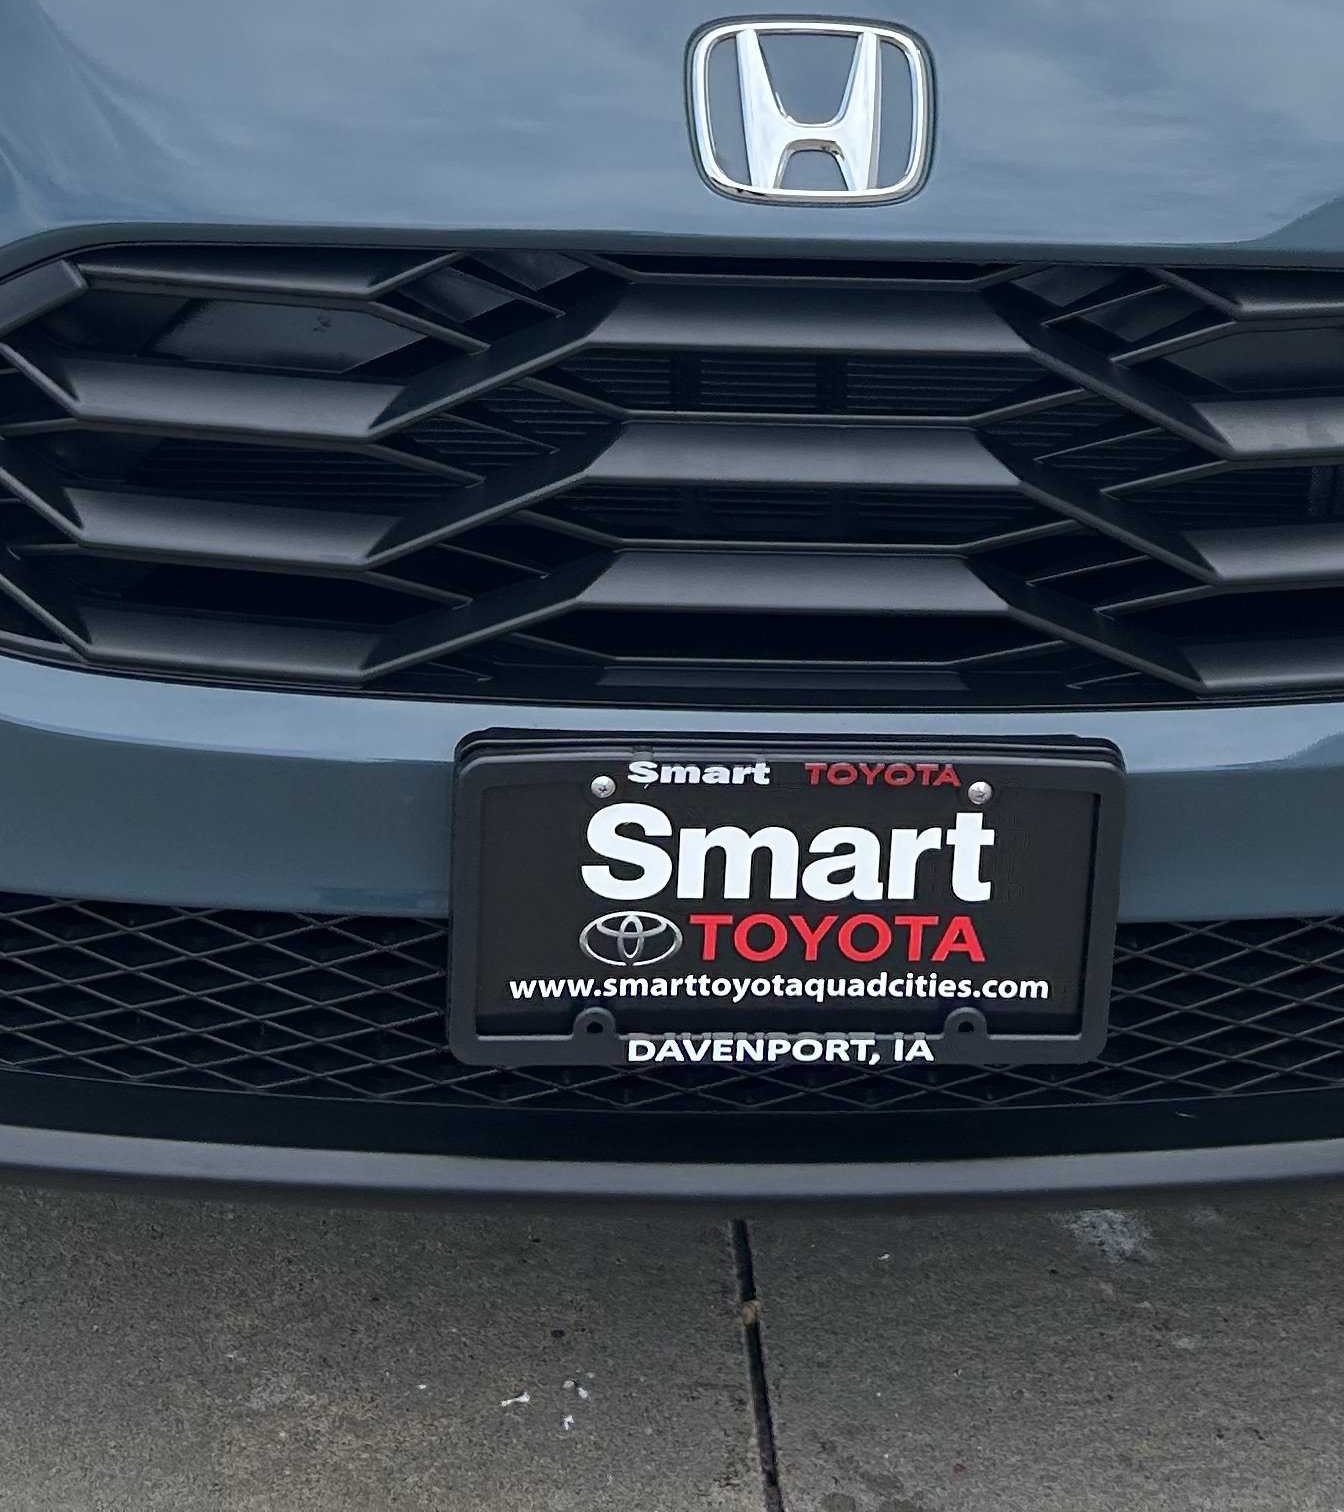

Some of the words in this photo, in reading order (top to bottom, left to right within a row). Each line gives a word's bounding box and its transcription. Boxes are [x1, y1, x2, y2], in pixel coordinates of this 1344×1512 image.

[628, 761, 770, 786] Smart
[804, 763, 961, 787] TOYOTA
[581, 803, 995, 902] Smart
[688, 913, 986, 963] TOYOTA
[508, 972, 1049, 1004] www.smarttoyotaquadcities.com
[627, 1038, 881, 1066] DAVENPORT,
[893, 1039, 935, 1063] IA
